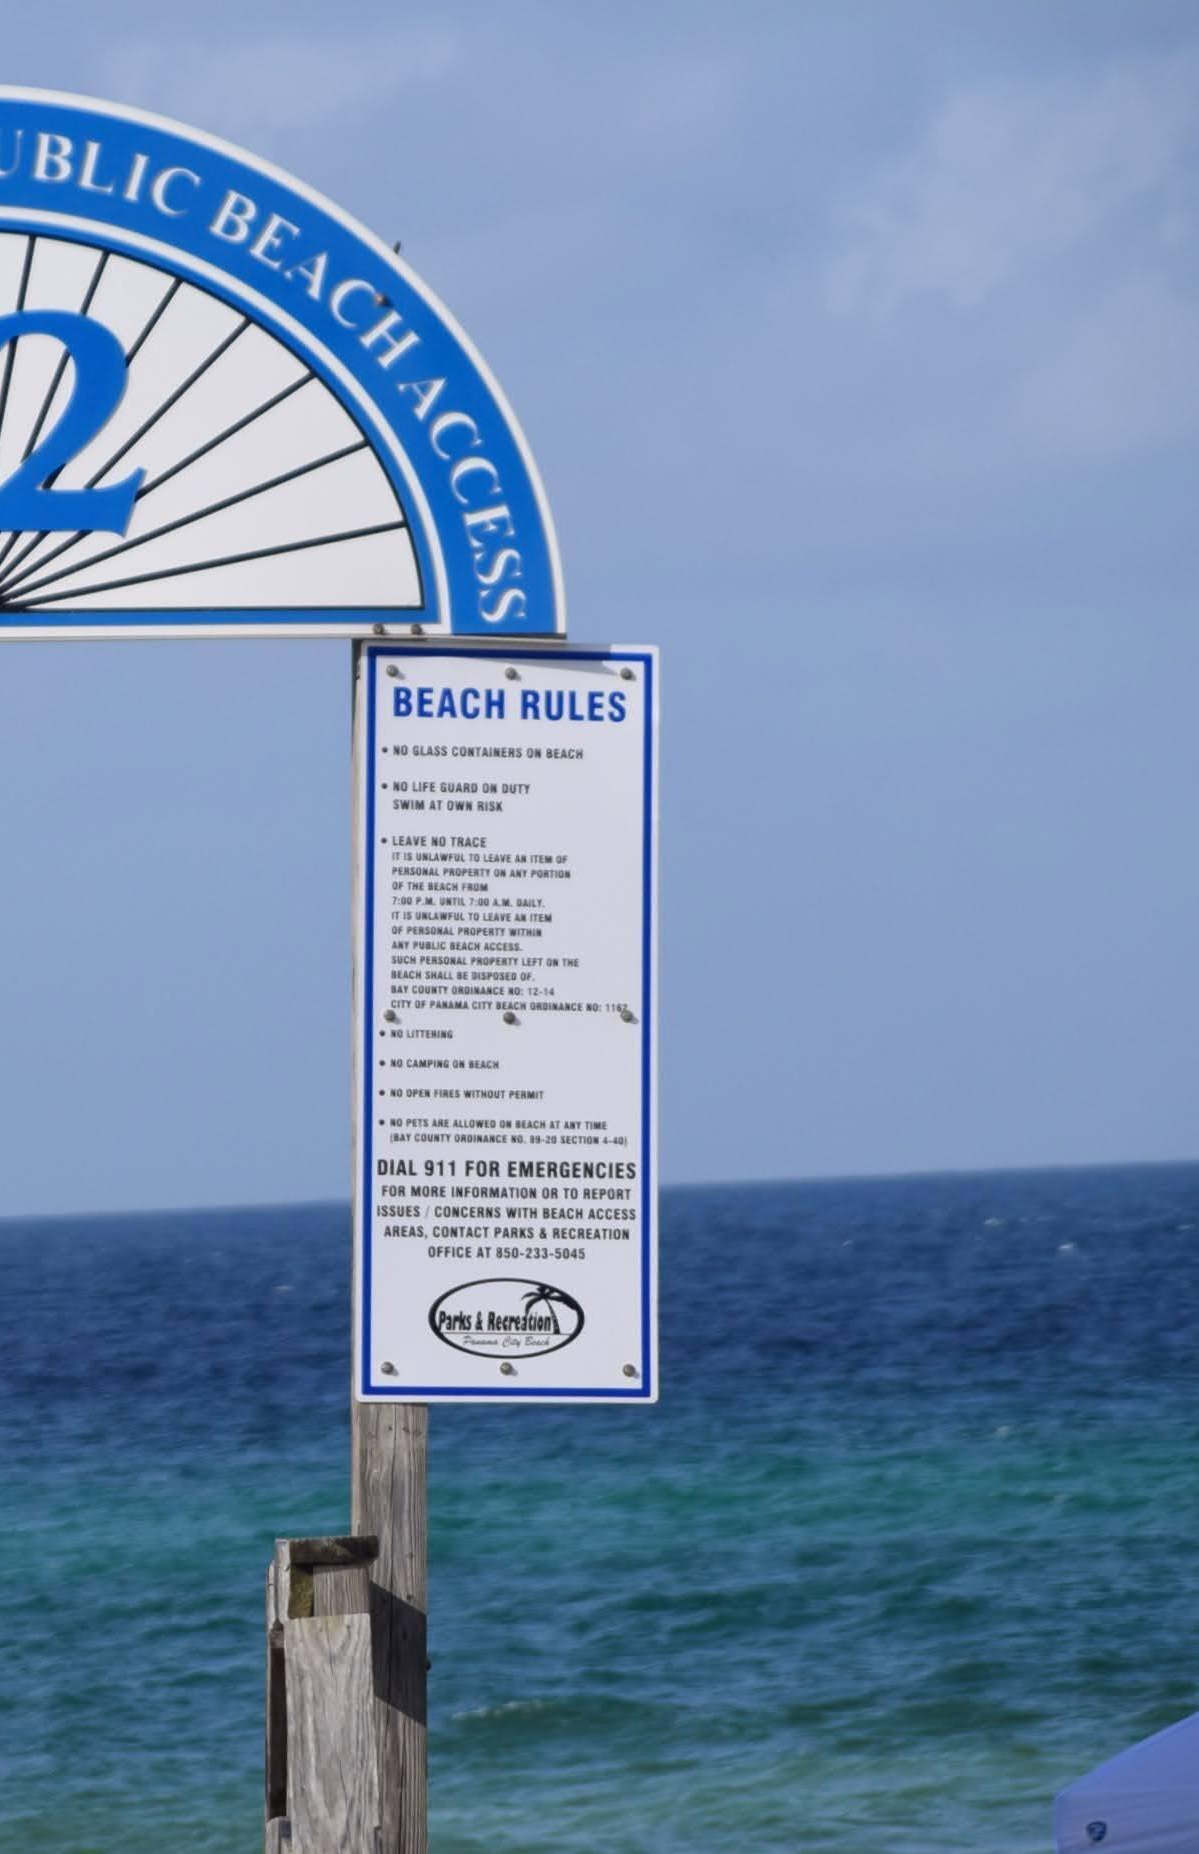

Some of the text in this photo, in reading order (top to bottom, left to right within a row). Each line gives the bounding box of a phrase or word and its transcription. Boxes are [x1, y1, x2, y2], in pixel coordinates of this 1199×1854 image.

[209, 189, 420, 369] BEACH
[399, 376, 526, 625] ACCESS
[394, 687, 626, 722] BEACH RULES
[393, 745, 583, 759] NO GLASS CONTAINERS ON BEACH
[393, 781, 530, 794] NO LIFE GUARD ON DUTY
[393, 800, 502, 811] SWIM AT OWN RISK
[393, 836, 486, 848] LEAVE NO TRACE
[392, 852, 567, 864] IT IS UNLAWFUL TO LEAVE AN ITEM OF
[392, 882, 488, 891] OF THE BEACH FROM
[392, 897, 412, 906] 7:00
[416, 897, 436, 906] P.M.
[439, 898, 466, 906] UNTIL
[469, 898, 489, 906] 7:00
[391, 1030, 453, 1039] NO LITTERING
[391, 1059, 499, 1069] NO CAMPING ON BEACH
[390, 1089, 543, 1099] NO OPEN FIRES WITHOUT PERMIT
[390, 1119, 402, 1127] NO
[406, 1119, 428, 1127] PETS
[432, 1119, 449, 1127] ARE
[453, 1120, 496, 1128] ALLOWED
[500, 1120, 511, 1128] ON
[515, 1120, 545, 1129] BEACH
[550, 1121, 560, 1129] AT
[585, 1121, 606, 1130] TIME
[415, 1134, 451, 1143] COUNTY
[454, 1134, 507, 1143] ORDINANCE
[560, 1135, 599, 1145] SECTION
[378, 1159, 635, 1179] DIAL 911 FOR EMERGENCIES
[382, 1185, 630, 1200] FOR MORE INFORMATION OR TO REPORT
[376, 1205, 421, 1217] ISSUES
[434, 1206, 501, 1218] CONCERNS
[506, 1207, 538, 1219] WITH
[543, 1208, 583, 1219] BEACH
[588, 1208, 636, 1220] ACCESS
[384, 1226, 629, 1240] AREAS, CONTACT PARKS & RECREATION
[428, 1246, 585, 1259] OFFICE AT 850-233-5045
[438, 1311, 551, 1331] Parks & Recreation
[463, 1335, 550, 1347] Panama City Beach
